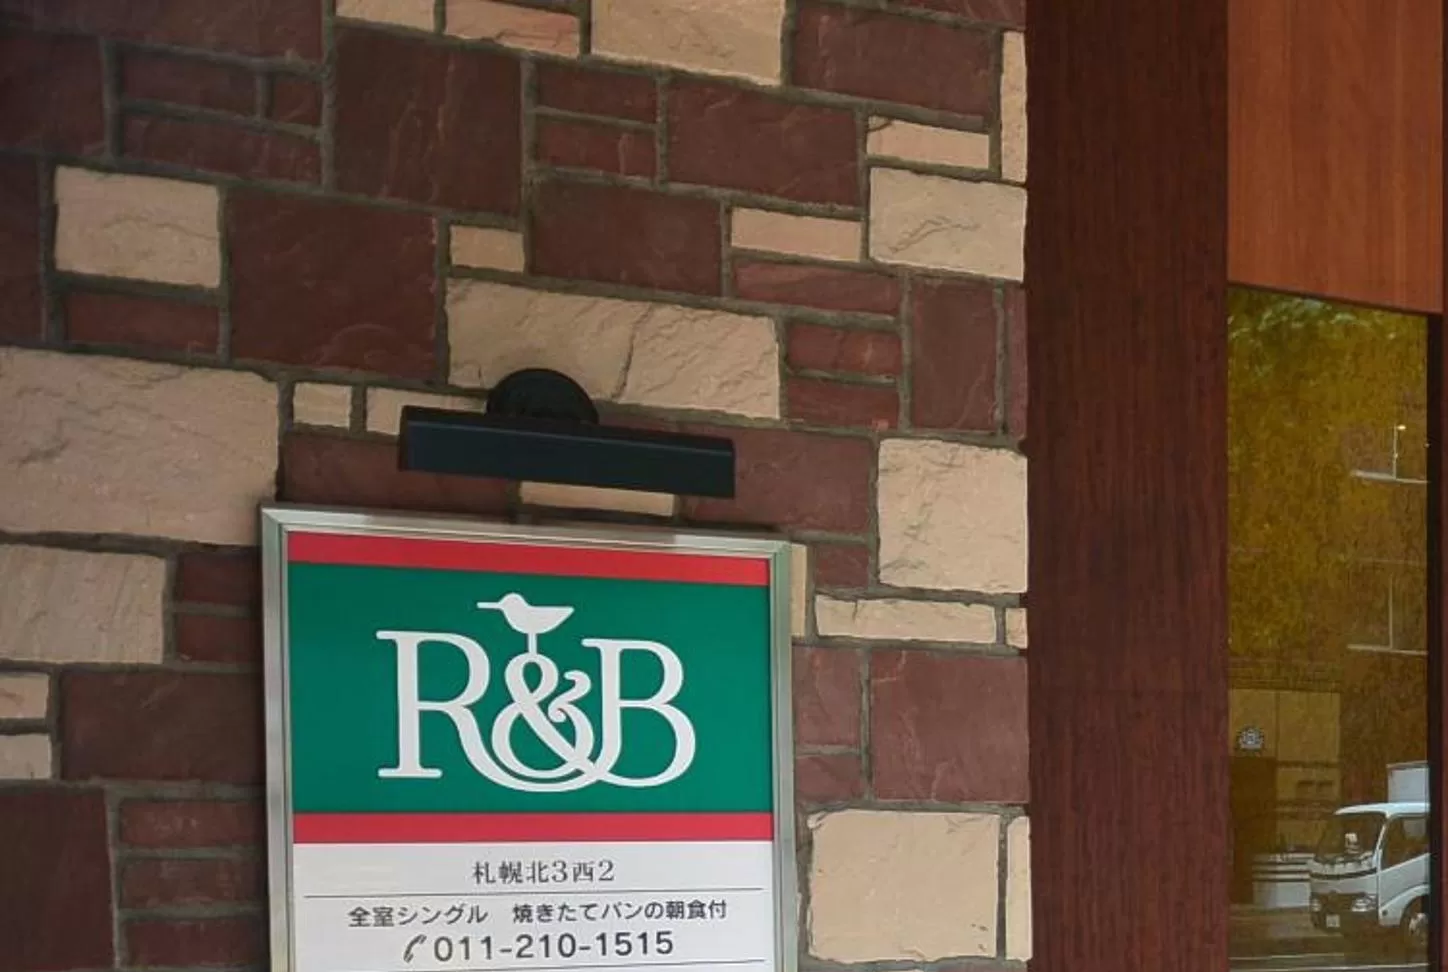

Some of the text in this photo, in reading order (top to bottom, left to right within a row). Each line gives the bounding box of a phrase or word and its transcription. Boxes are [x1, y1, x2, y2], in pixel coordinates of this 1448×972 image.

[376, 630, 697, 793] R&B
[473, 860, 615, 884] 札幌北3西2
[348, 903, 488, 928] 全室シングル
[433, 930, 673, 962] 011-210-1515
